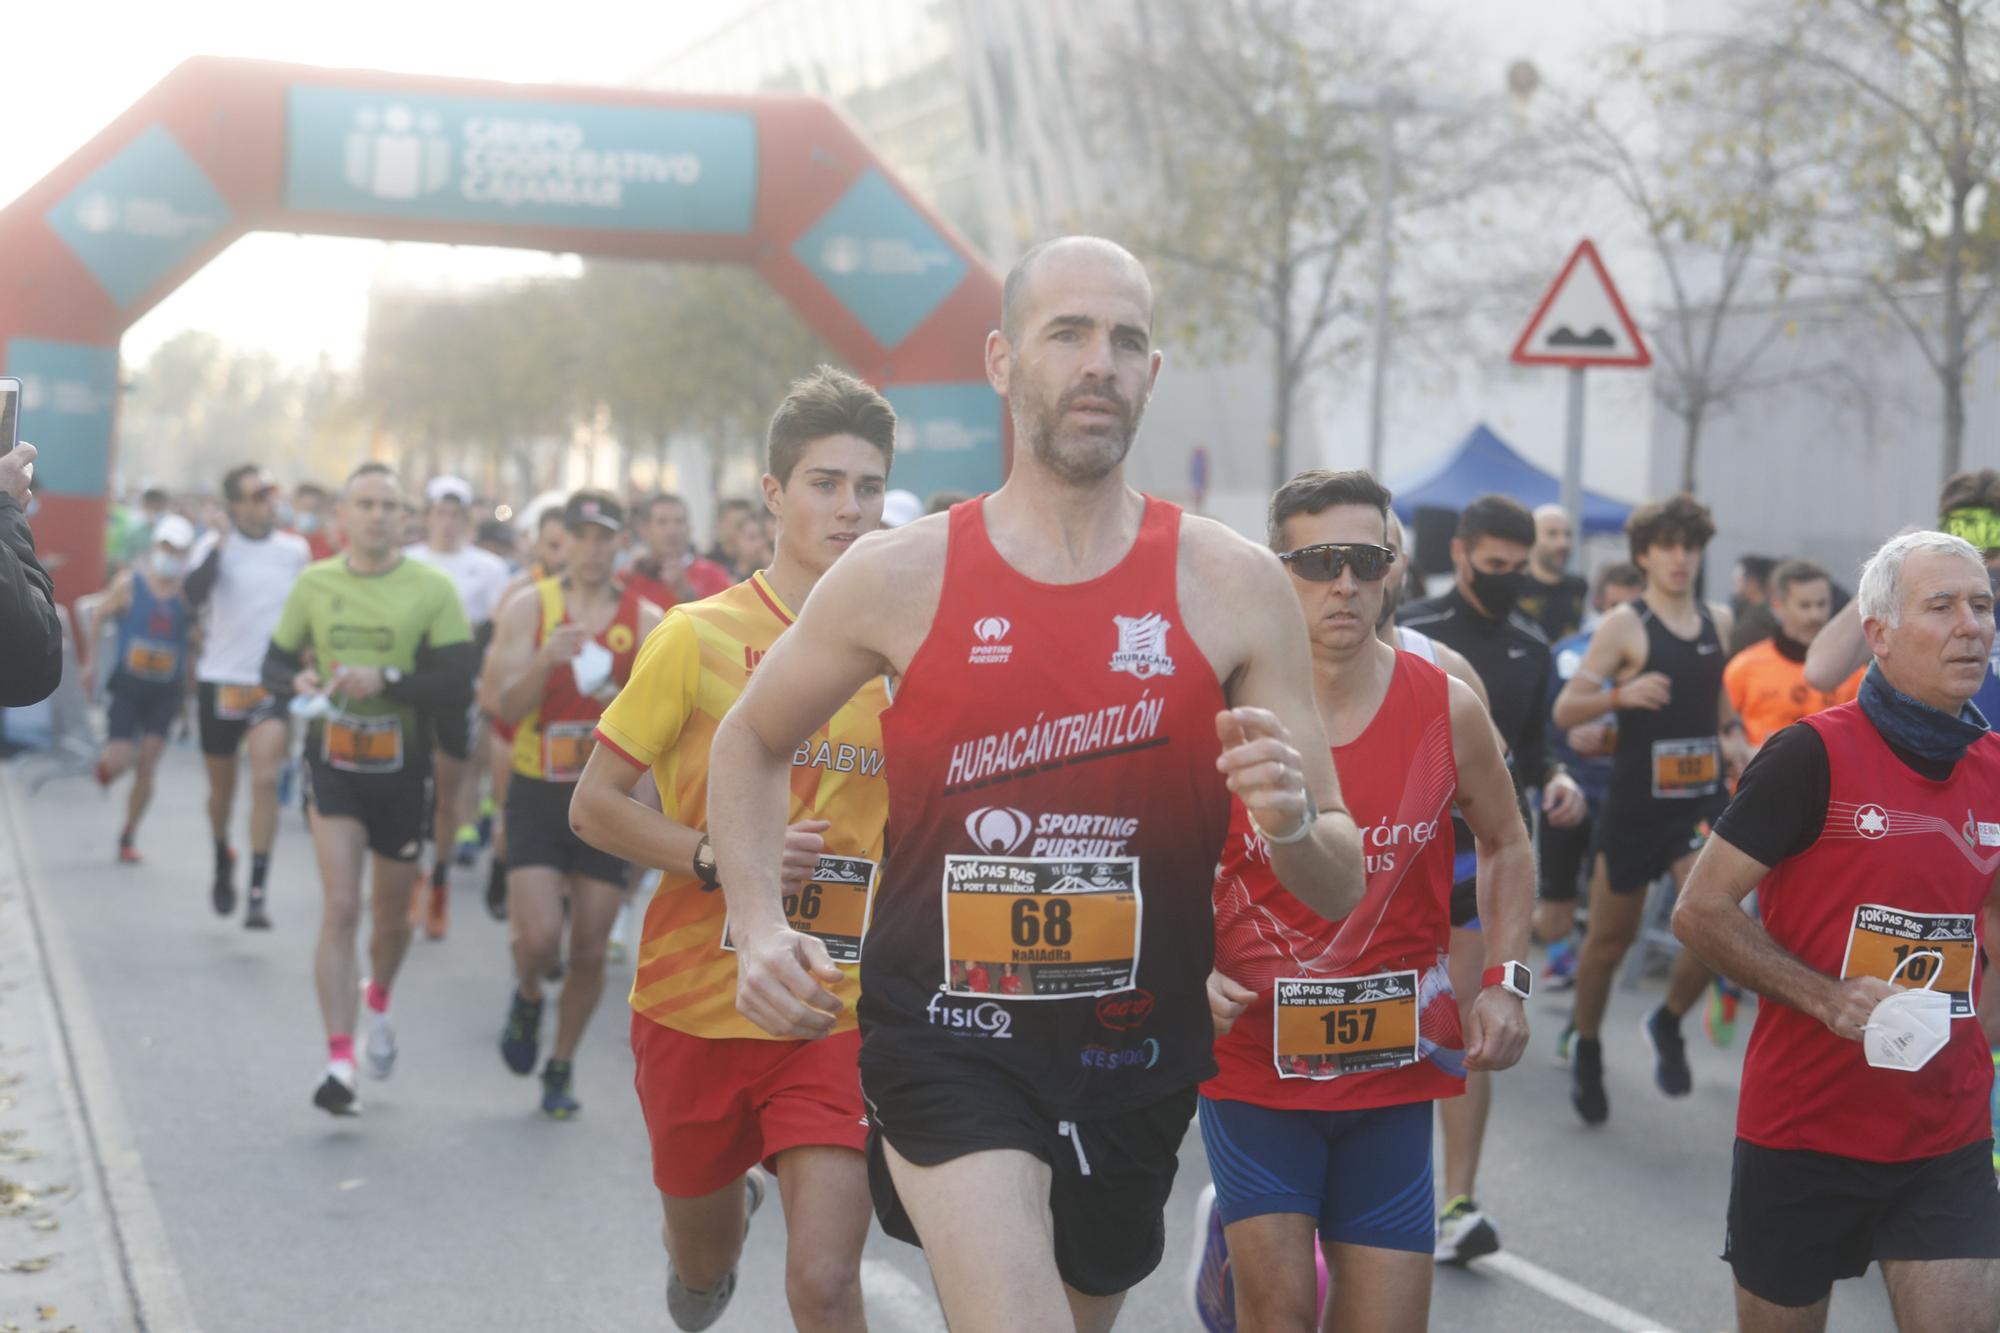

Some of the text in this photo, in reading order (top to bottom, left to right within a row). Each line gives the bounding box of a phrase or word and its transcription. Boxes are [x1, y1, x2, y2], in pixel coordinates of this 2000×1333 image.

[464, 119, 583, 148] GRUPO
[463, 149, 701, 185] COOPERATIVO
[971, 645, 1013, 654] SPORTING
[1115, 653, 1169, 666] HURACÁN
[946, 689, 1164, 785] HURACÁNTRIATLÓN
[1035, 813, 1138, 836] SPORTING
[1030, 838, 1128, 858] PURSUIT
[949, 862, 978, 882] 10K
[979, 865, 1007, 878] PAS
[1009, 867, 1036, 884] RAS
[1366, 852, 1395, 874] US
[963, 882, 984, 892] PORT
[986, 883, 998, 892] DE
[1011, 898, 1072, 947] 68
[1859, 908, 1881, 923] 10K
[1882, 912, 1904, 926] PAS
[1903, 917, 1924, 934] RAS
[1867, 923, 1884, 933] PORT
[1280, 983, 1301, 998] 10K
[1302, 985, 1323, 995] PAS
[1325, 986, 1346, 998] RAS
[1290, 997, 1307, 1005] PORT
[1320, 1007, 1377, 1045] 157
